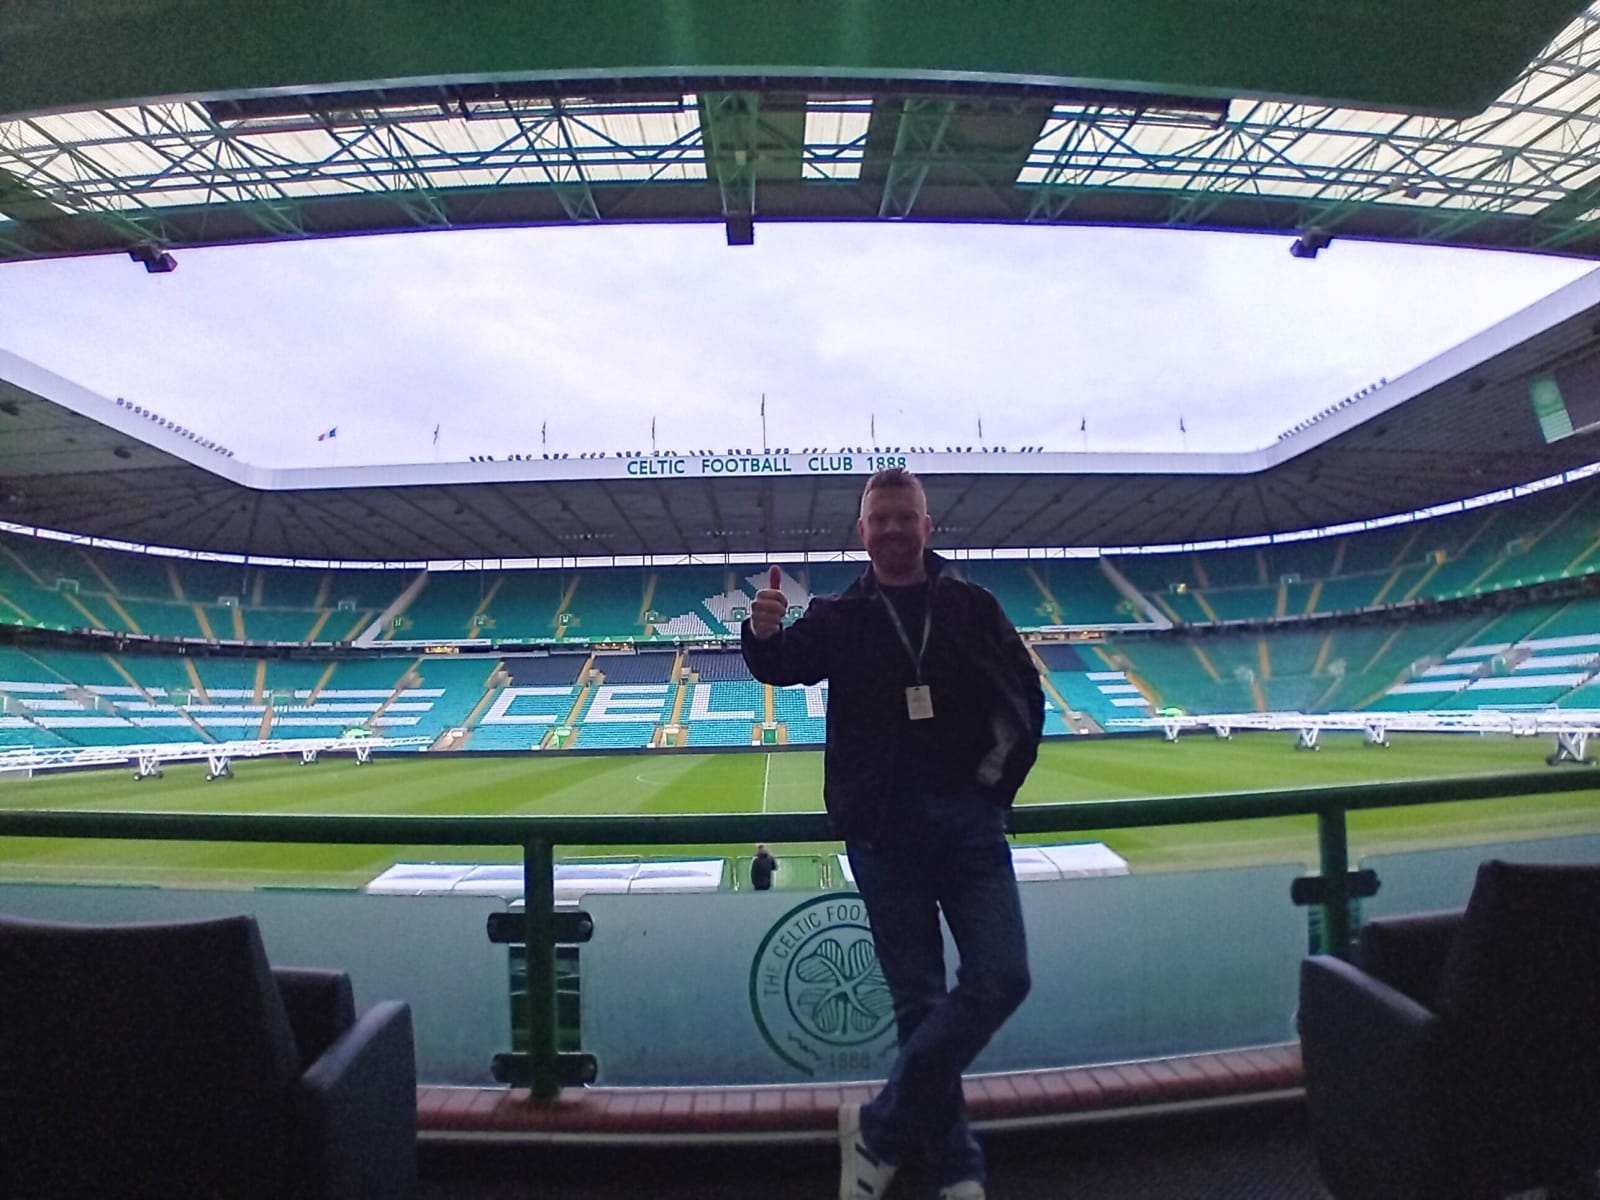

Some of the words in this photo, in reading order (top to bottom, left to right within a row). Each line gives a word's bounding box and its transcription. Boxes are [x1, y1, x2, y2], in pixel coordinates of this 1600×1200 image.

[627, 460, 685, 475] CELTIC
[701, 457, 792, 473] FOOTBALL
[808, 457, 853, 471] CLUB
[867, 456, 906, 471] 1888
[764, 964, 782, 998] THE
[774, 912, 822, 959] CELTIC
[826, 904, 869, 923] FOO
